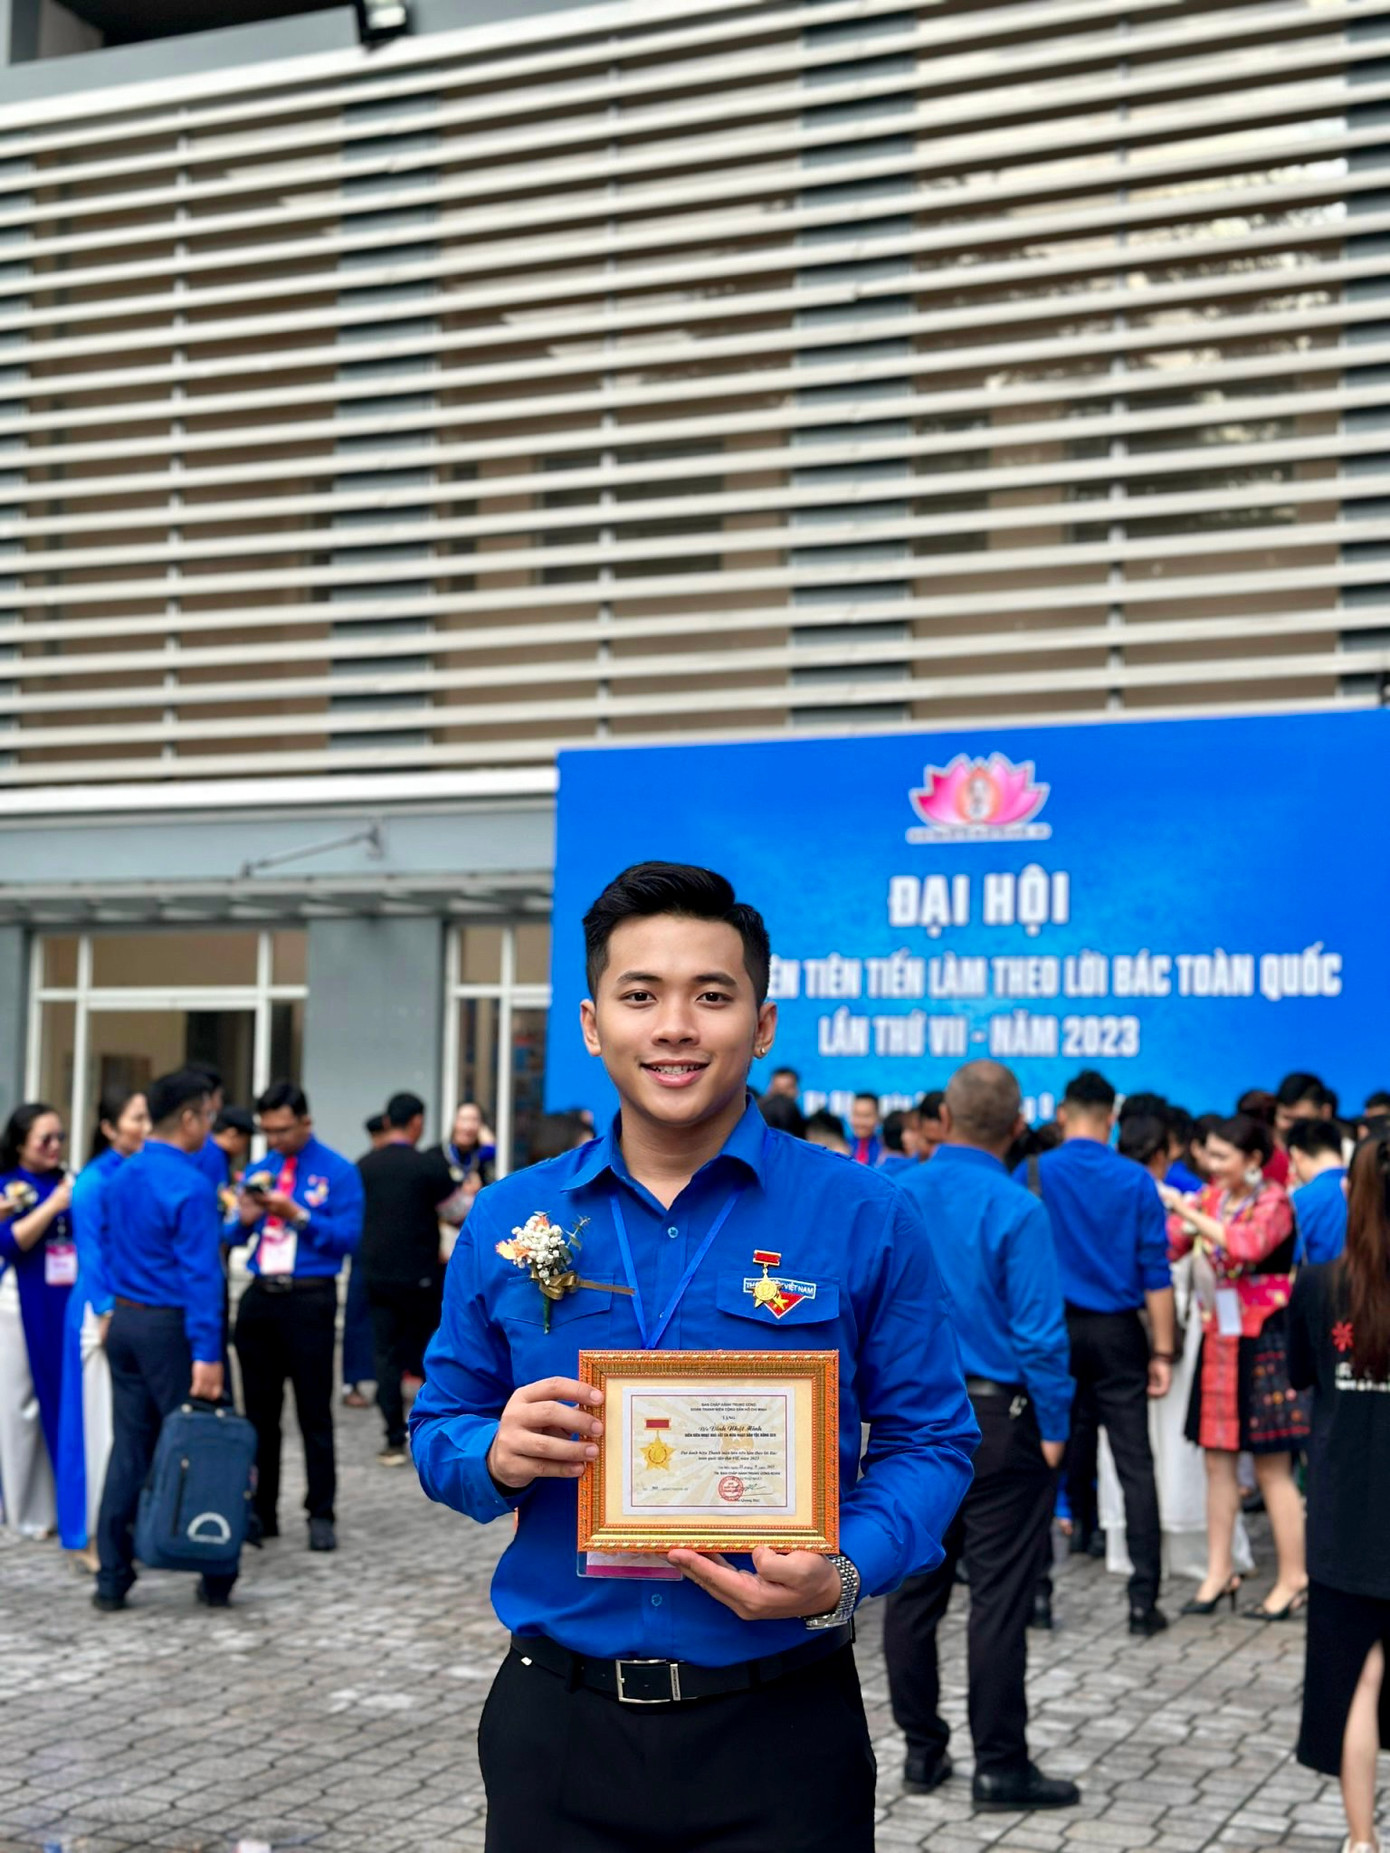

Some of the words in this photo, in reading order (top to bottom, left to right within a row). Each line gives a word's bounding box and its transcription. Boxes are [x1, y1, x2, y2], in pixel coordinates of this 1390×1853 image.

[888, 874, 970, 938] ĐẠI
[983, 863, 1069, 937] HỘI
[768, 953, 799, 998] ÊN
[804, 952, 862, 998] TIÊN
[866, 947, 925, 998] TIẾN
[928, 951, 987, 998] LÀM
[991, 956, 1059, 998] THEO
[1064, 949, 1109, 997] LỜI
[1112, 948, 1172, 996] BÁC
[1175, 947, 1255, 996] TOÀN
[1259, 941, 1343, 1001] QUỐC
[929, 1015, 968, 1057] VII
[989, 1008, 1058, 1057] NĂM
[1062, 1014, 1140, 1057] 2023
[798, 1286, 814, 1294] NAM
